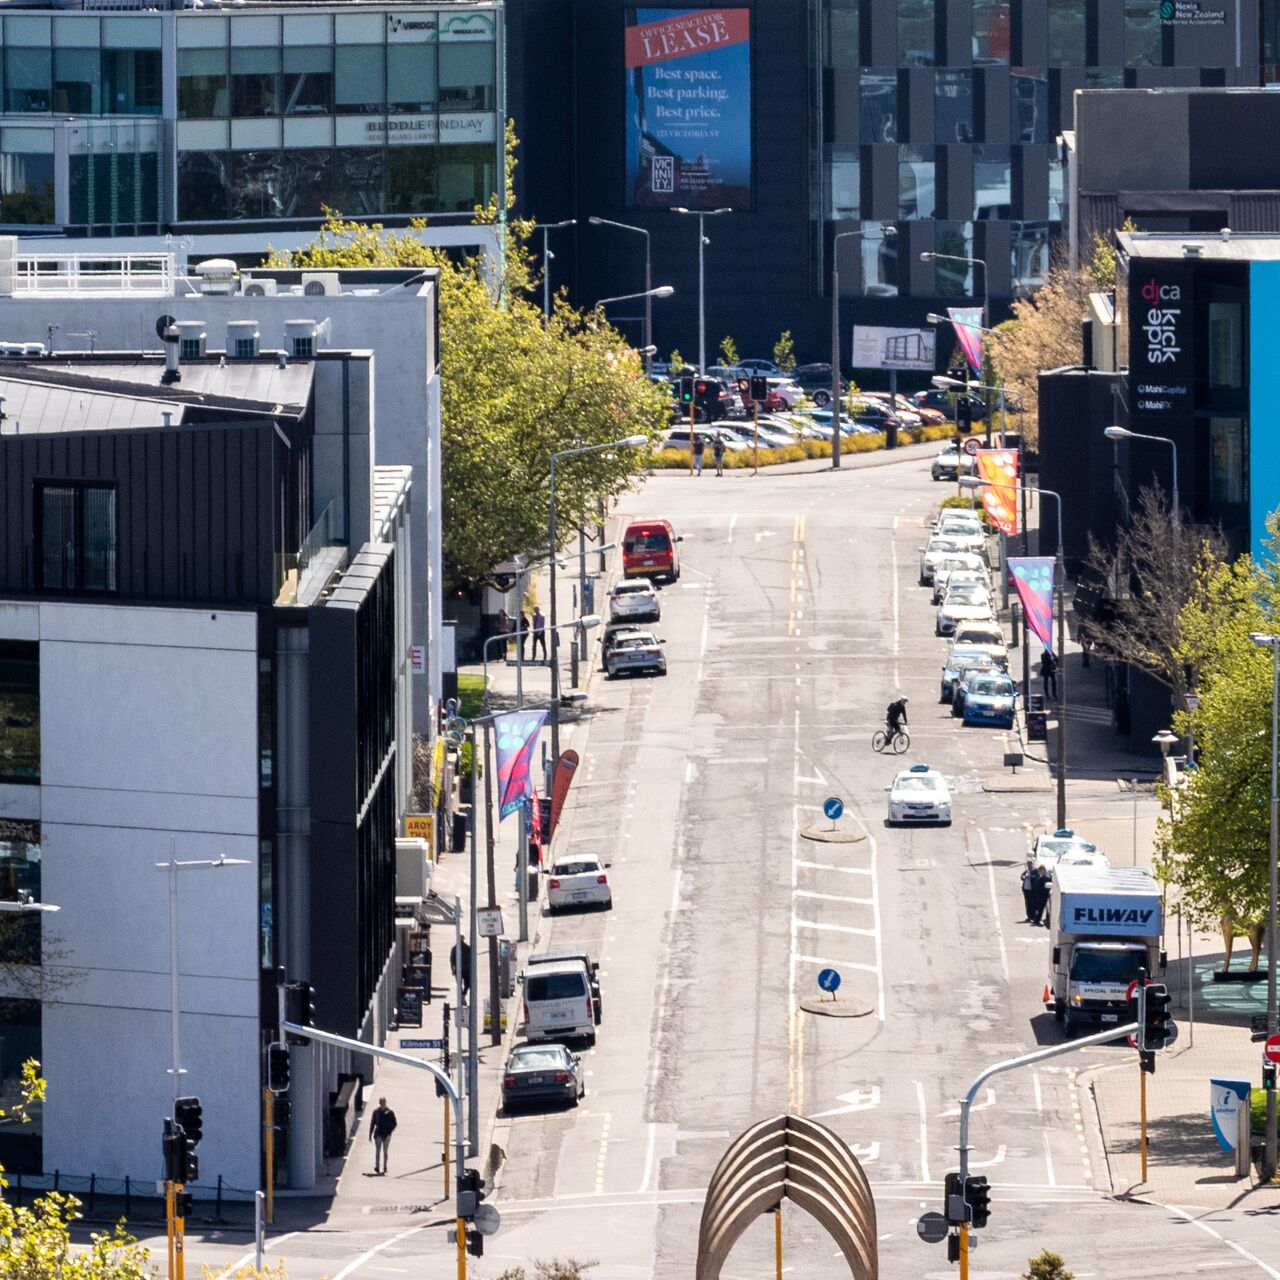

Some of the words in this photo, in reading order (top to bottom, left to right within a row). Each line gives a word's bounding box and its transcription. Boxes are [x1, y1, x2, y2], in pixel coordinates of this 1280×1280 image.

[644, 21, 730, 58] LEASE
[656, 68, 680, 79] Best
[684, 70, 721, 82] space.
[648, 86, 674, 98] Best
[677, 86, 729, 101] parking.
[656, 105, 682, 117] Best
[685, 106, 721, 121] price.
[1142, 278, 1180, 305] djca
[1142, 308, 1161, 363] side
[1162, 309, 1180, 362] kick
[1074, 908, 1154, 923] FLIWAY
